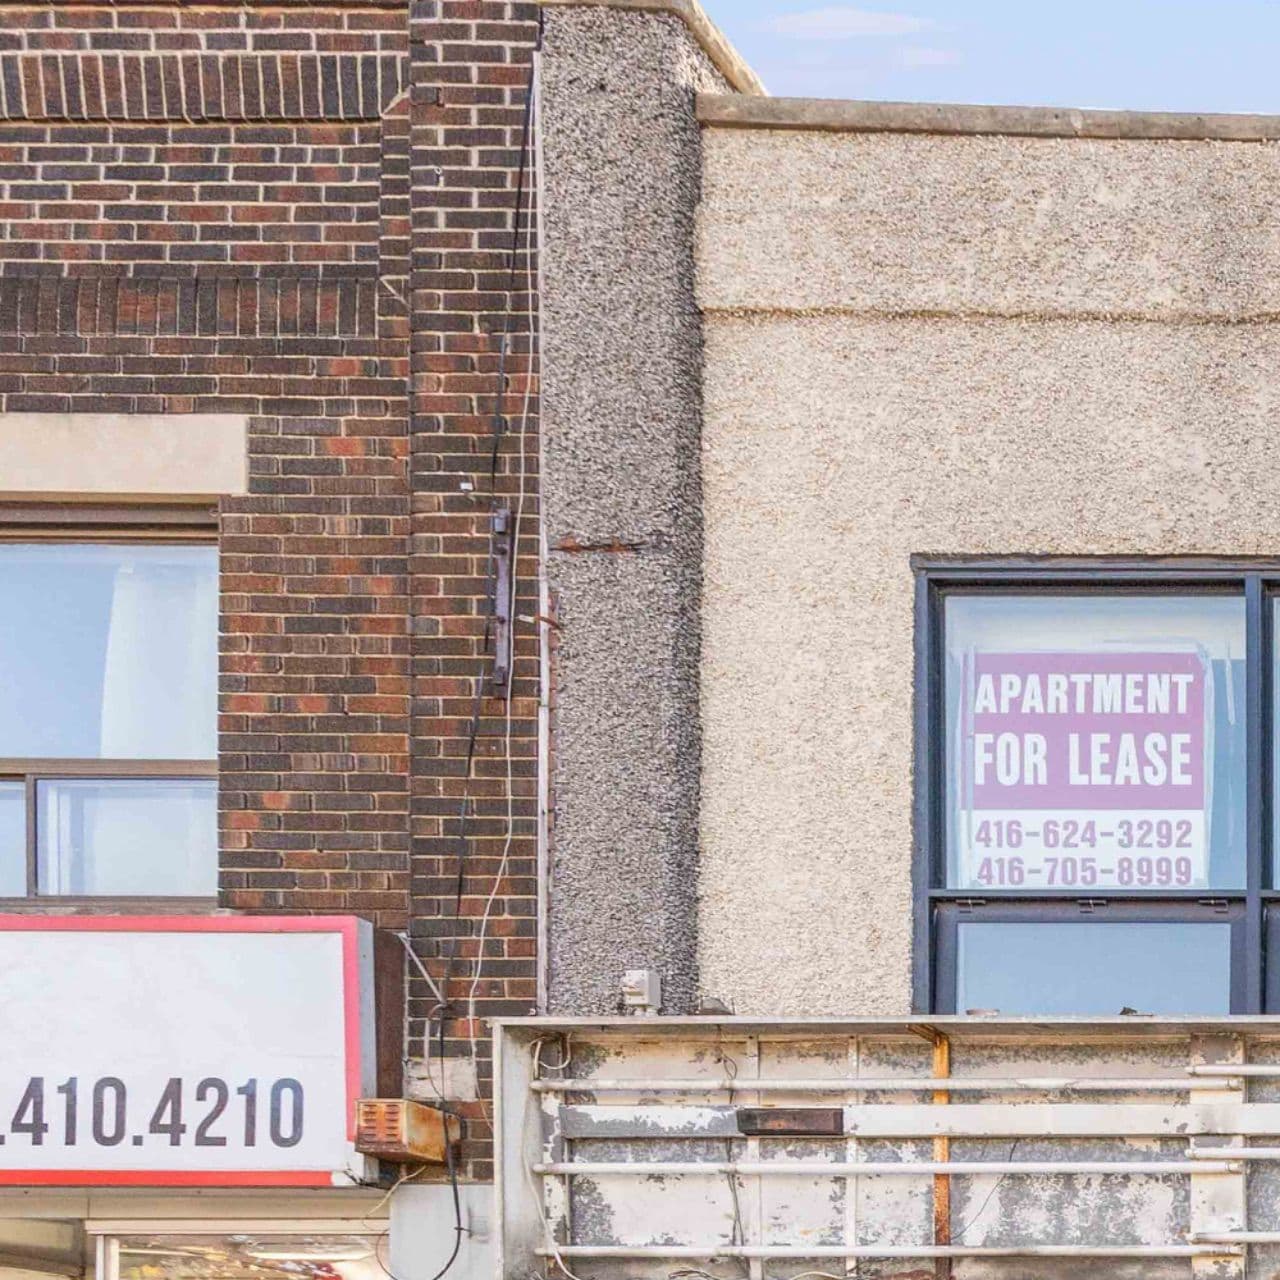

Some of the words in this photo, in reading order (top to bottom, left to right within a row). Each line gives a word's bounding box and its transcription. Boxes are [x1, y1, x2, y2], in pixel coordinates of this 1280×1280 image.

[974, 673, 1194, 714] APARTMENT
[973, 732, 1048, 786] FOR
[1068, 732, 1193, 786] LEASE
[975, 819, 1193, 850] 416-624-3292
[976, 856, 1193, 887] 416-705-8999
